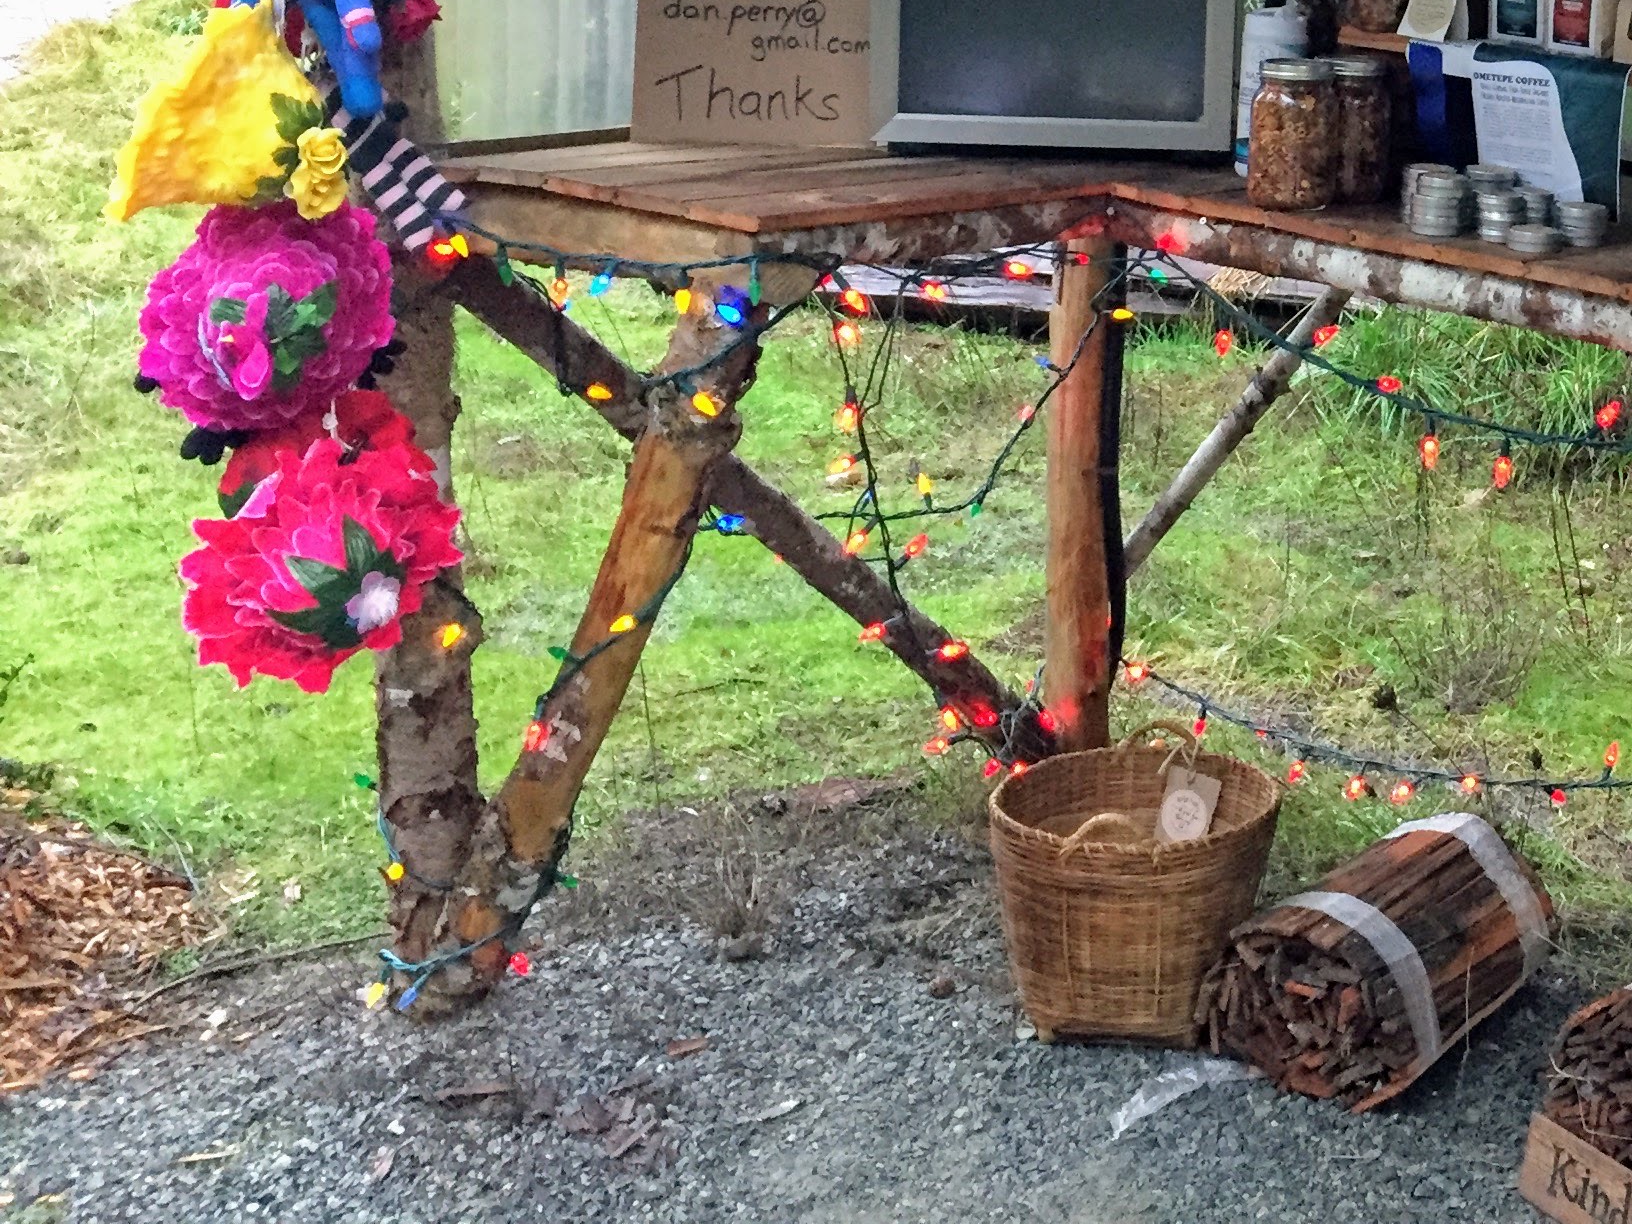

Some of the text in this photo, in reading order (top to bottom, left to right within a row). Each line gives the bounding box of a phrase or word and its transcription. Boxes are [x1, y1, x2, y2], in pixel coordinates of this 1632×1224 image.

[750, 26, 871, 61] gmail.com
[654, 64, 841, 122] Thanks
[1515, 76, 1550, 87] COFFEE
